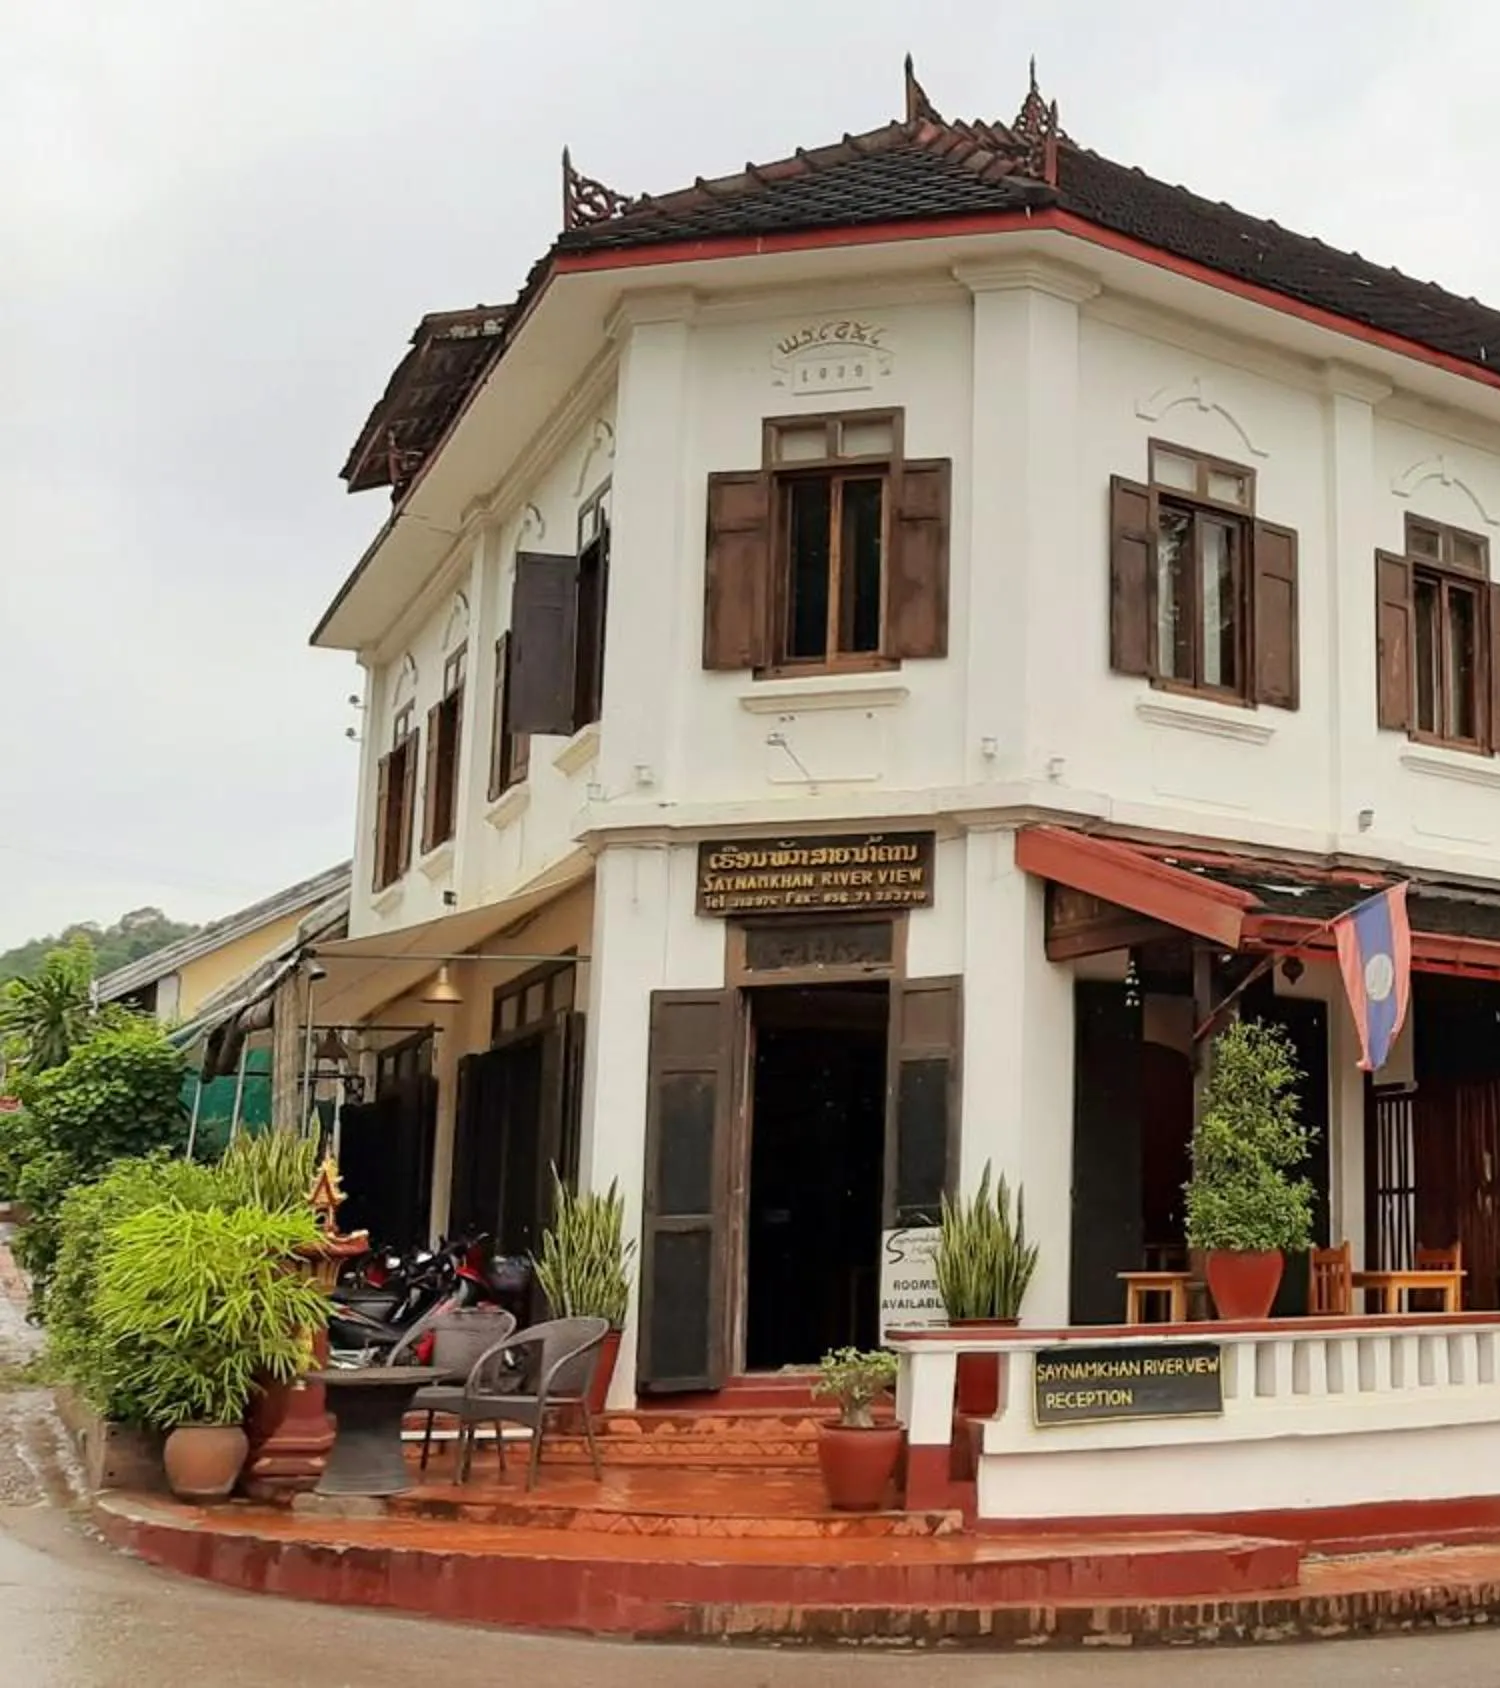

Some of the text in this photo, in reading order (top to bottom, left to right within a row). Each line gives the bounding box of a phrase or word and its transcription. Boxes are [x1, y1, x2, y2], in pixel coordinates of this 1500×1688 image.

[703, 866, 923, 892] SAYNAMKHAN RIVER VIEW
[893, 1279, 938, 1291] ROOMS
[881, 1297, 945, 1310] AVAILABL
[1037, 1356, 1219, 1382] SAYNAMKHAN RIVER VIEW
[1045, 1389, 1133, 1409] RECEPTION
